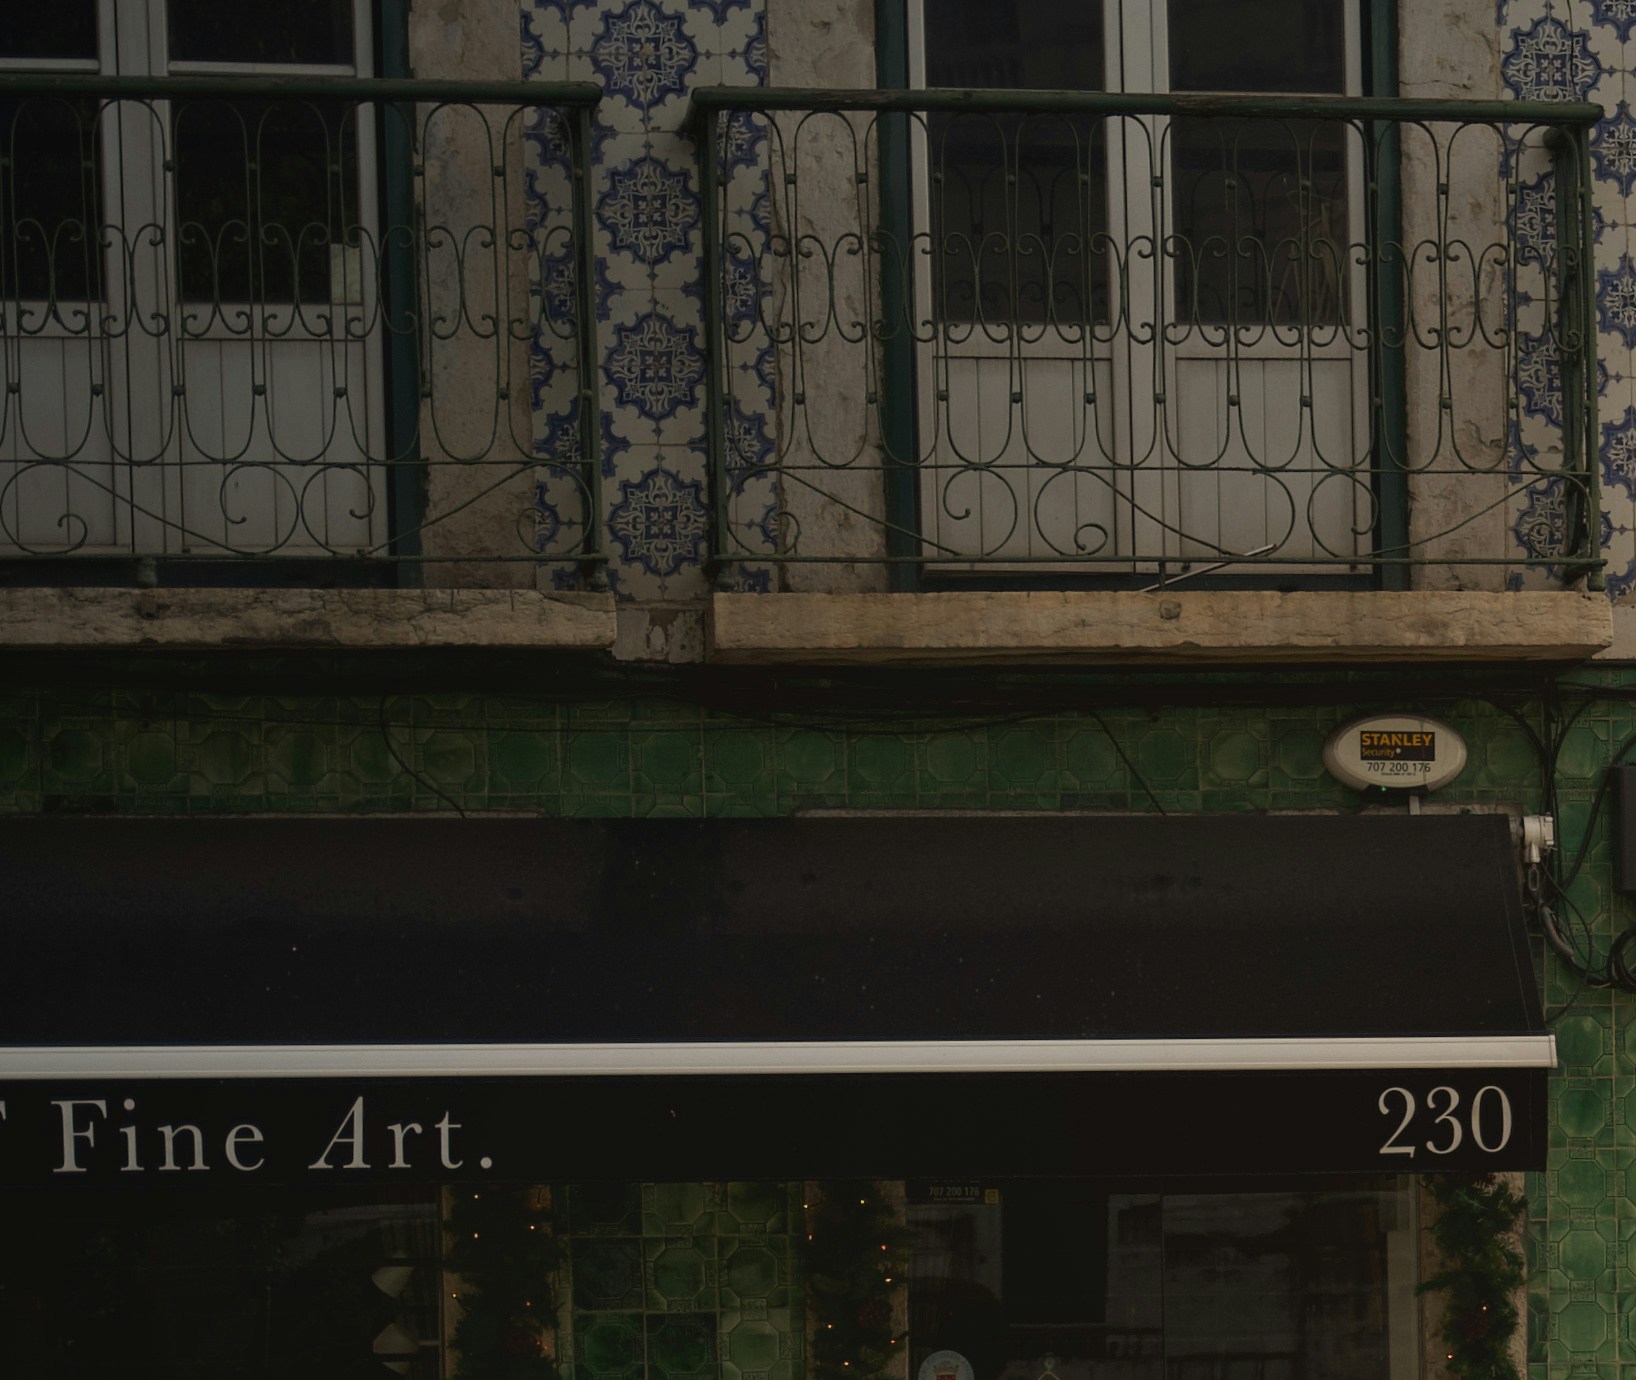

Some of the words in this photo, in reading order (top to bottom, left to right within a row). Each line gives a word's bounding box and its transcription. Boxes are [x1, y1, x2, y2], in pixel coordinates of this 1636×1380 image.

[1362, 733, 1432, 746] STANLEY
[1362, 747, 1395, 758] Security
[1367, 762, 1386, 772] 707
[1389, 762, 1409, 772] 200
[1412, 763, 1431, 772] 176
[1377, 1085, 1513, 1159] 230
[49, 1096, 266, 1174] Fine
[306, 1095, 495, 1171] Art.
[929, 1186, 944, 1197] 707
[946, 1186, 962, 1197] 200
